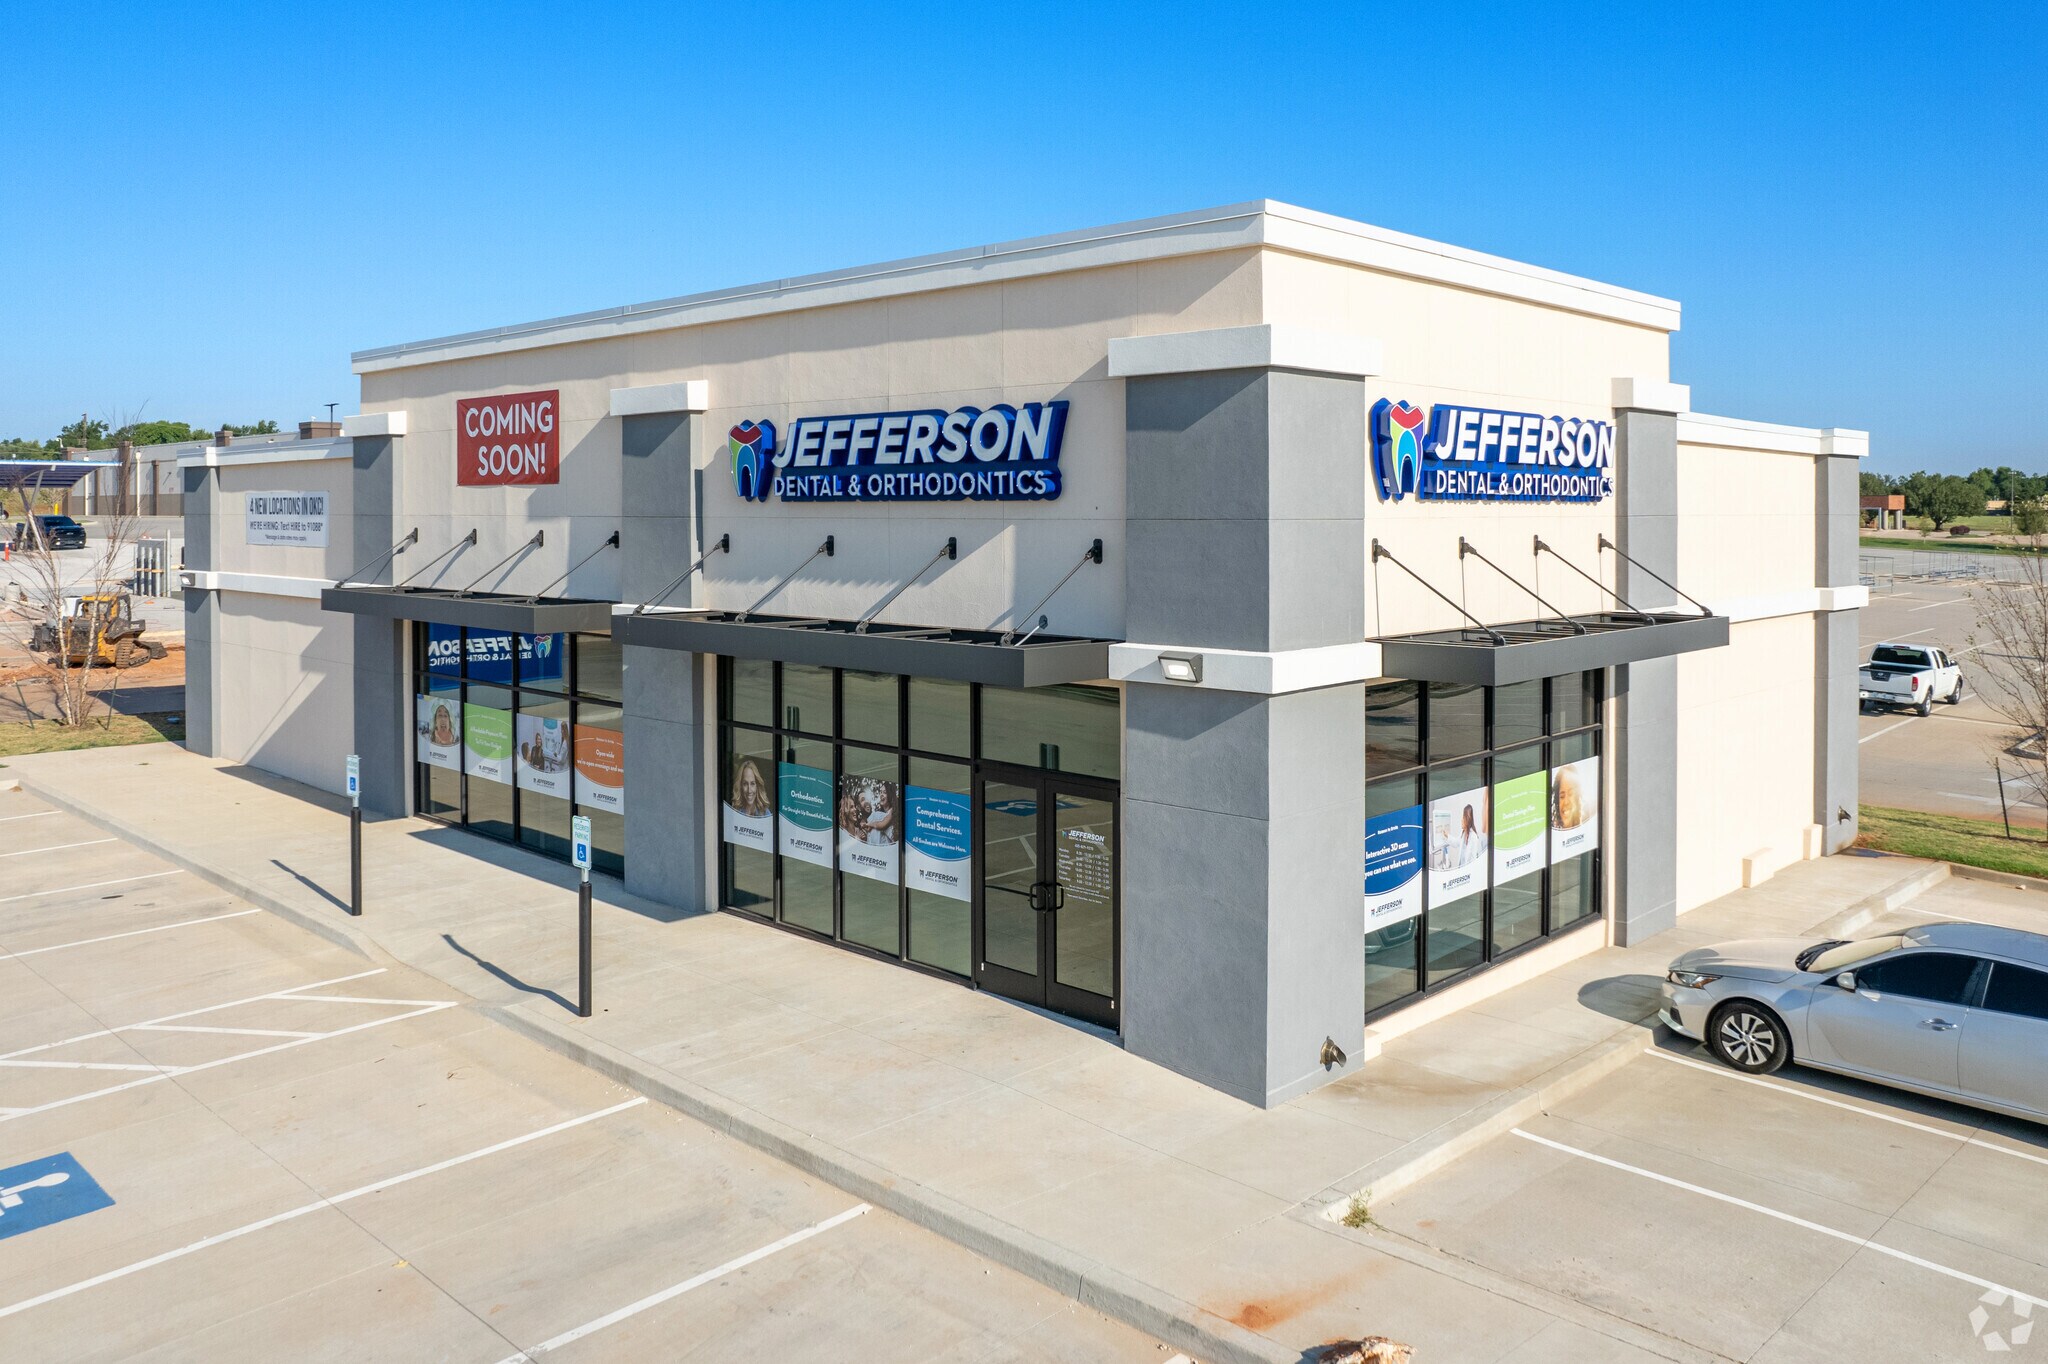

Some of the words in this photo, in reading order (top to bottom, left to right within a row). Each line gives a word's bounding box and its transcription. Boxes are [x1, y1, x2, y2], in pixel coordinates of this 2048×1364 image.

[465, 401, 553, 437] COMING
[772, 407, 1053, 468] JEFFERSON
[1435, 409, 1617, 468] JEFFERSON
[478, 443, 545, 476] SOON!
[774, 473, 843, 497] DENTAL
[848, 474, 861, 497] &
[867, 469, 1047, 496] ORTHODONTICS
[1436, 470, 1494, 494] DENTAL
[1499, 473, 1509, 495] &
[1512, 472, 1614, 498] ORTHODONTICS
[250, 498, 254, 515] 4
[254, 497, 267, 515] NEW
[269, 496, 301, 515] LOCATIONS
[302, 496, 308, 515] IN
[309, 496, 324, 515] OKC!
[790, 790, 825, 804] Orthodontics.
[916, 806, 960, 822] Comprehensive
[738, 826, 765, 838] JEFFERSON
[916, 819, 936, 830] Dental
[936, 822, 963, 836] Services.
[1068, 830, 1105, 843] JEFFERSON
[794, 839, 823, 852] JEFFERSON
[1365, 846, 1391, 860] Interactive
[1390, 842, 1399, 852] 3D
[857, 854, 888, 867] JEFFERSON
[1389, 859, 1401, 871] what
[925, 870, 959, 883] JEFFERSON
[1375, 898, 1403, 914] JEFFERSON
